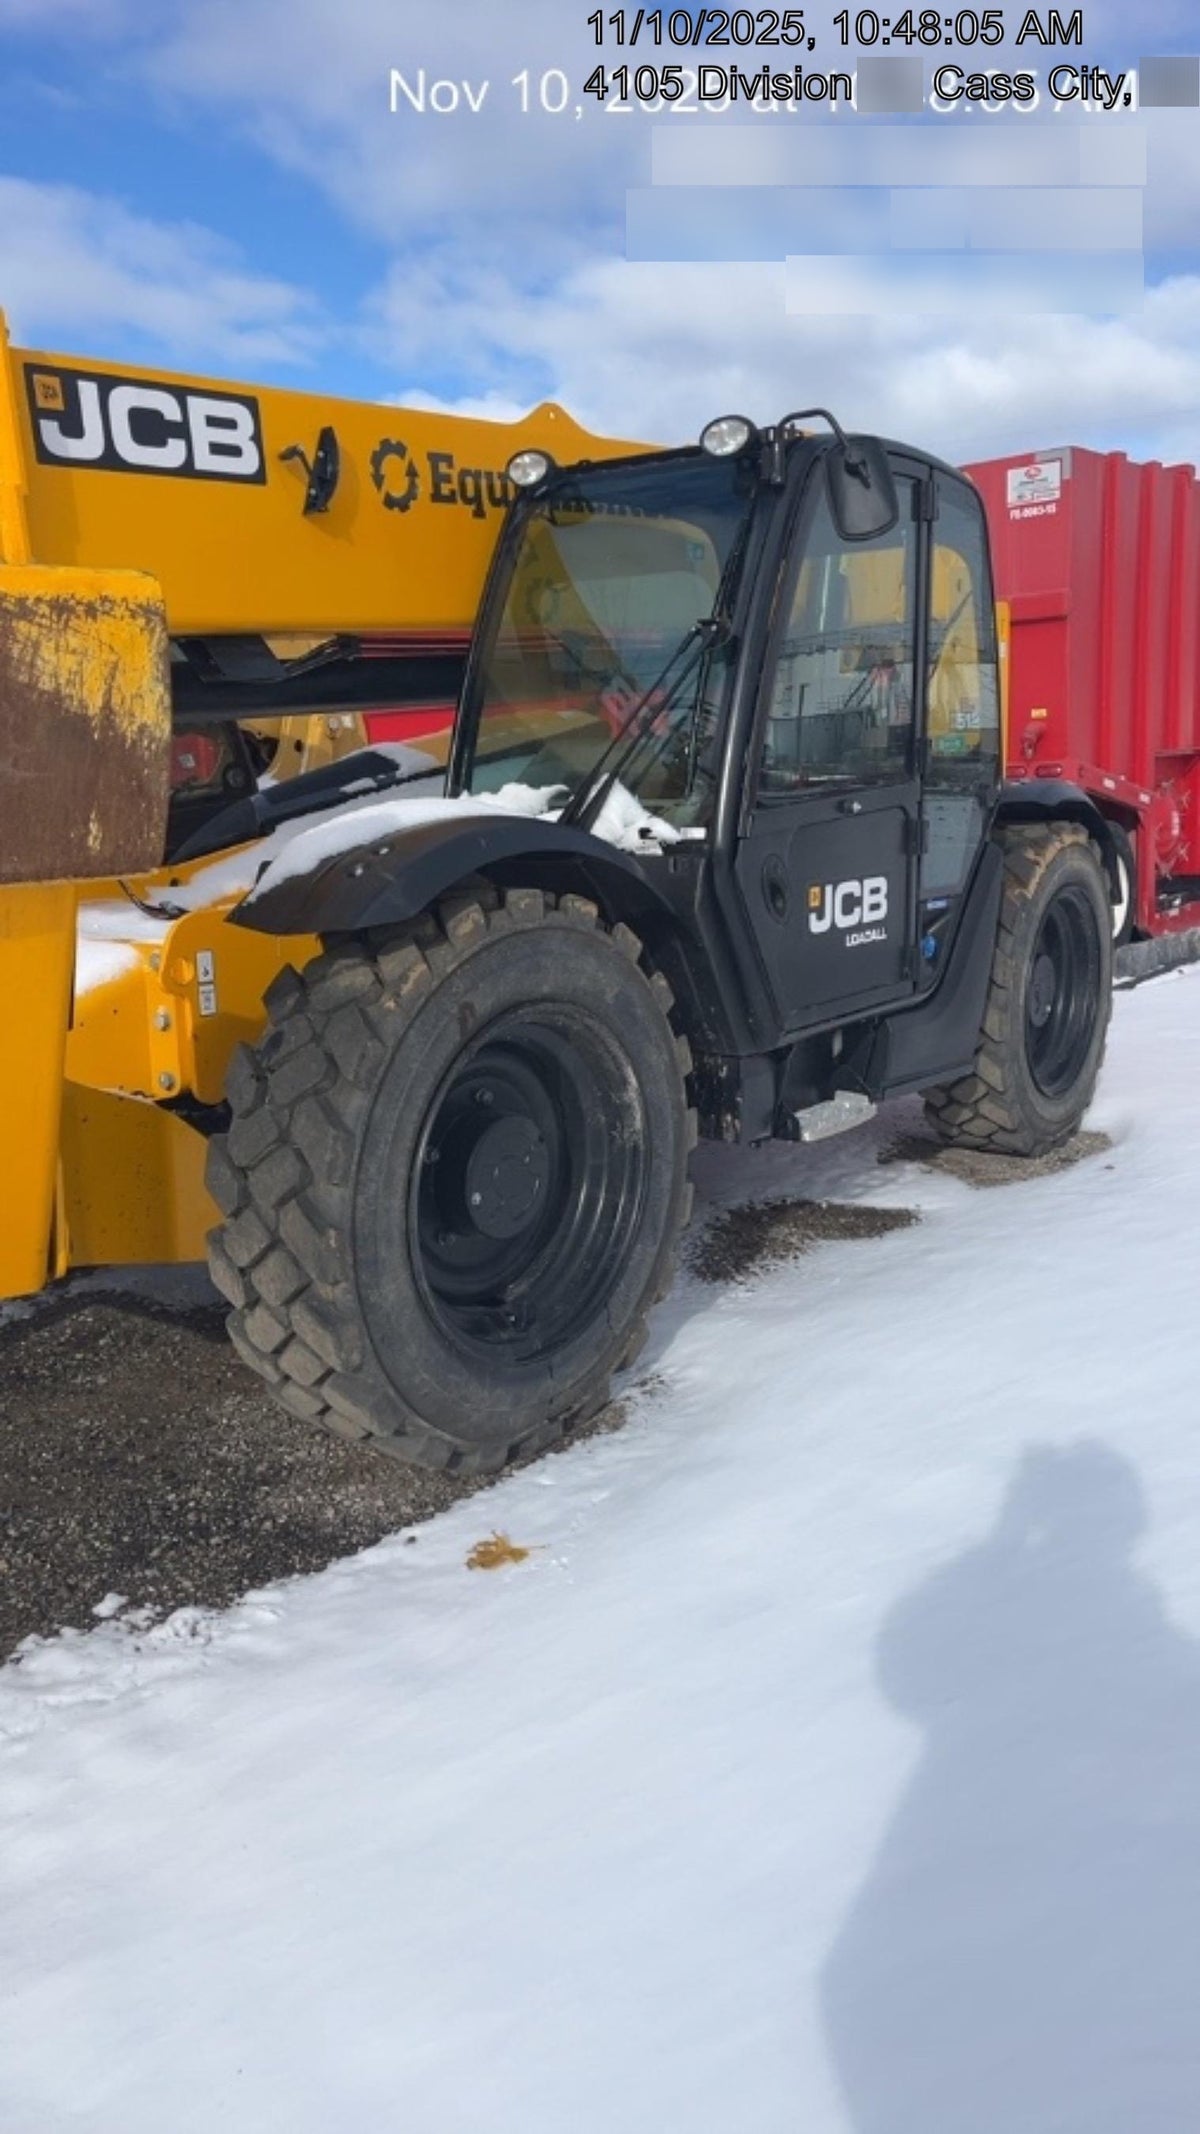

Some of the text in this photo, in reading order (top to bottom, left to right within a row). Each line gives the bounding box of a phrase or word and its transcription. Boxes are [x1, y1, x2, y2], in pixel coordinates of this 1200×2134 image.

[39, 379, 260, 475] JCB
[427, 453, 518, 518] Equ
[809, 876, 888, 933] JCB
[845, 927, 888, 947] LOADALL
